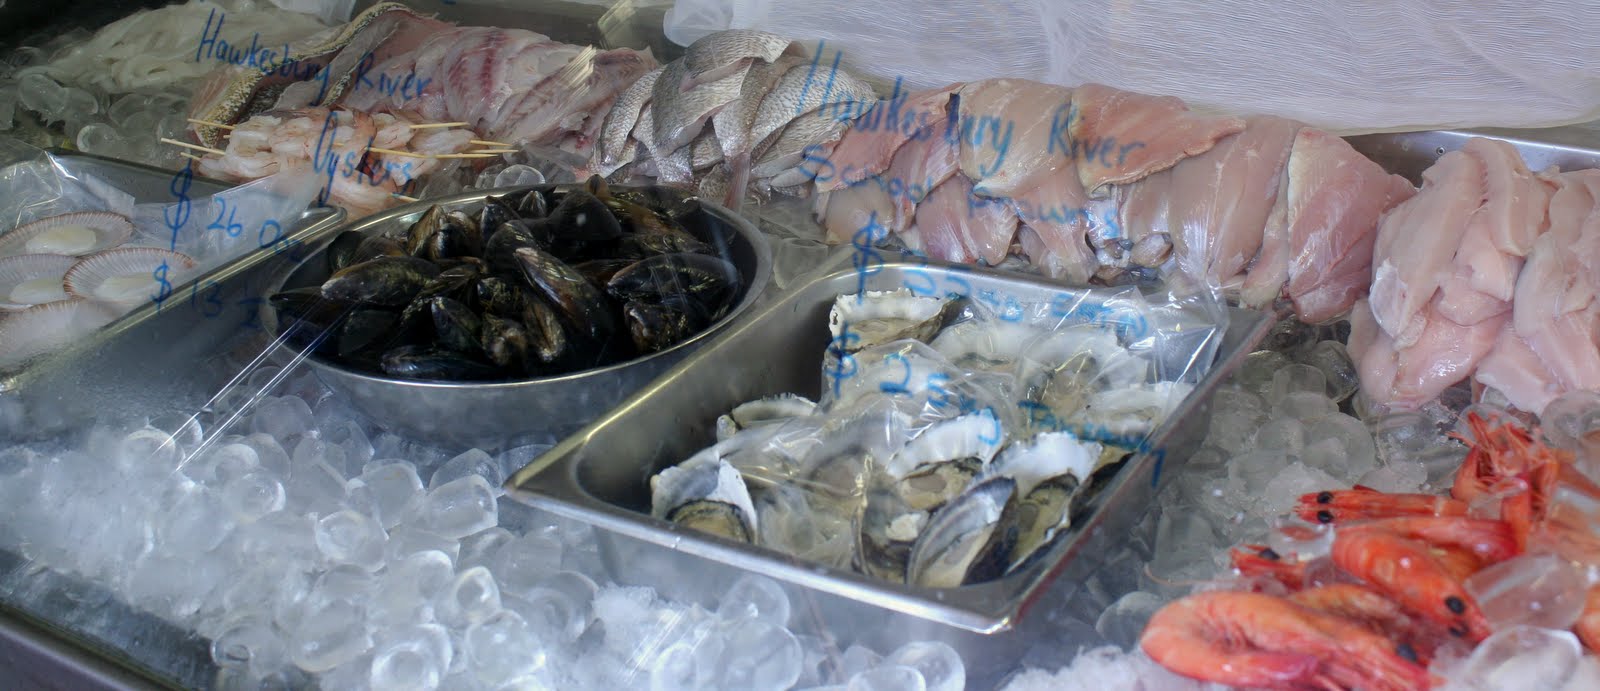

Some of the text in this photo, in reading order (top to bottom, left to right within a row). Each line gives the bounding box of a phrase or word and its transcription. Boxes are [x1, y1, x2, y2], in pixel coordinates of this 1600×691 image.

[196, 8, 432, 106] Hawkesbury River
[796, 40, 1146, 178] Hawkesbury River
[312, 110, 413, 207] Oysters
